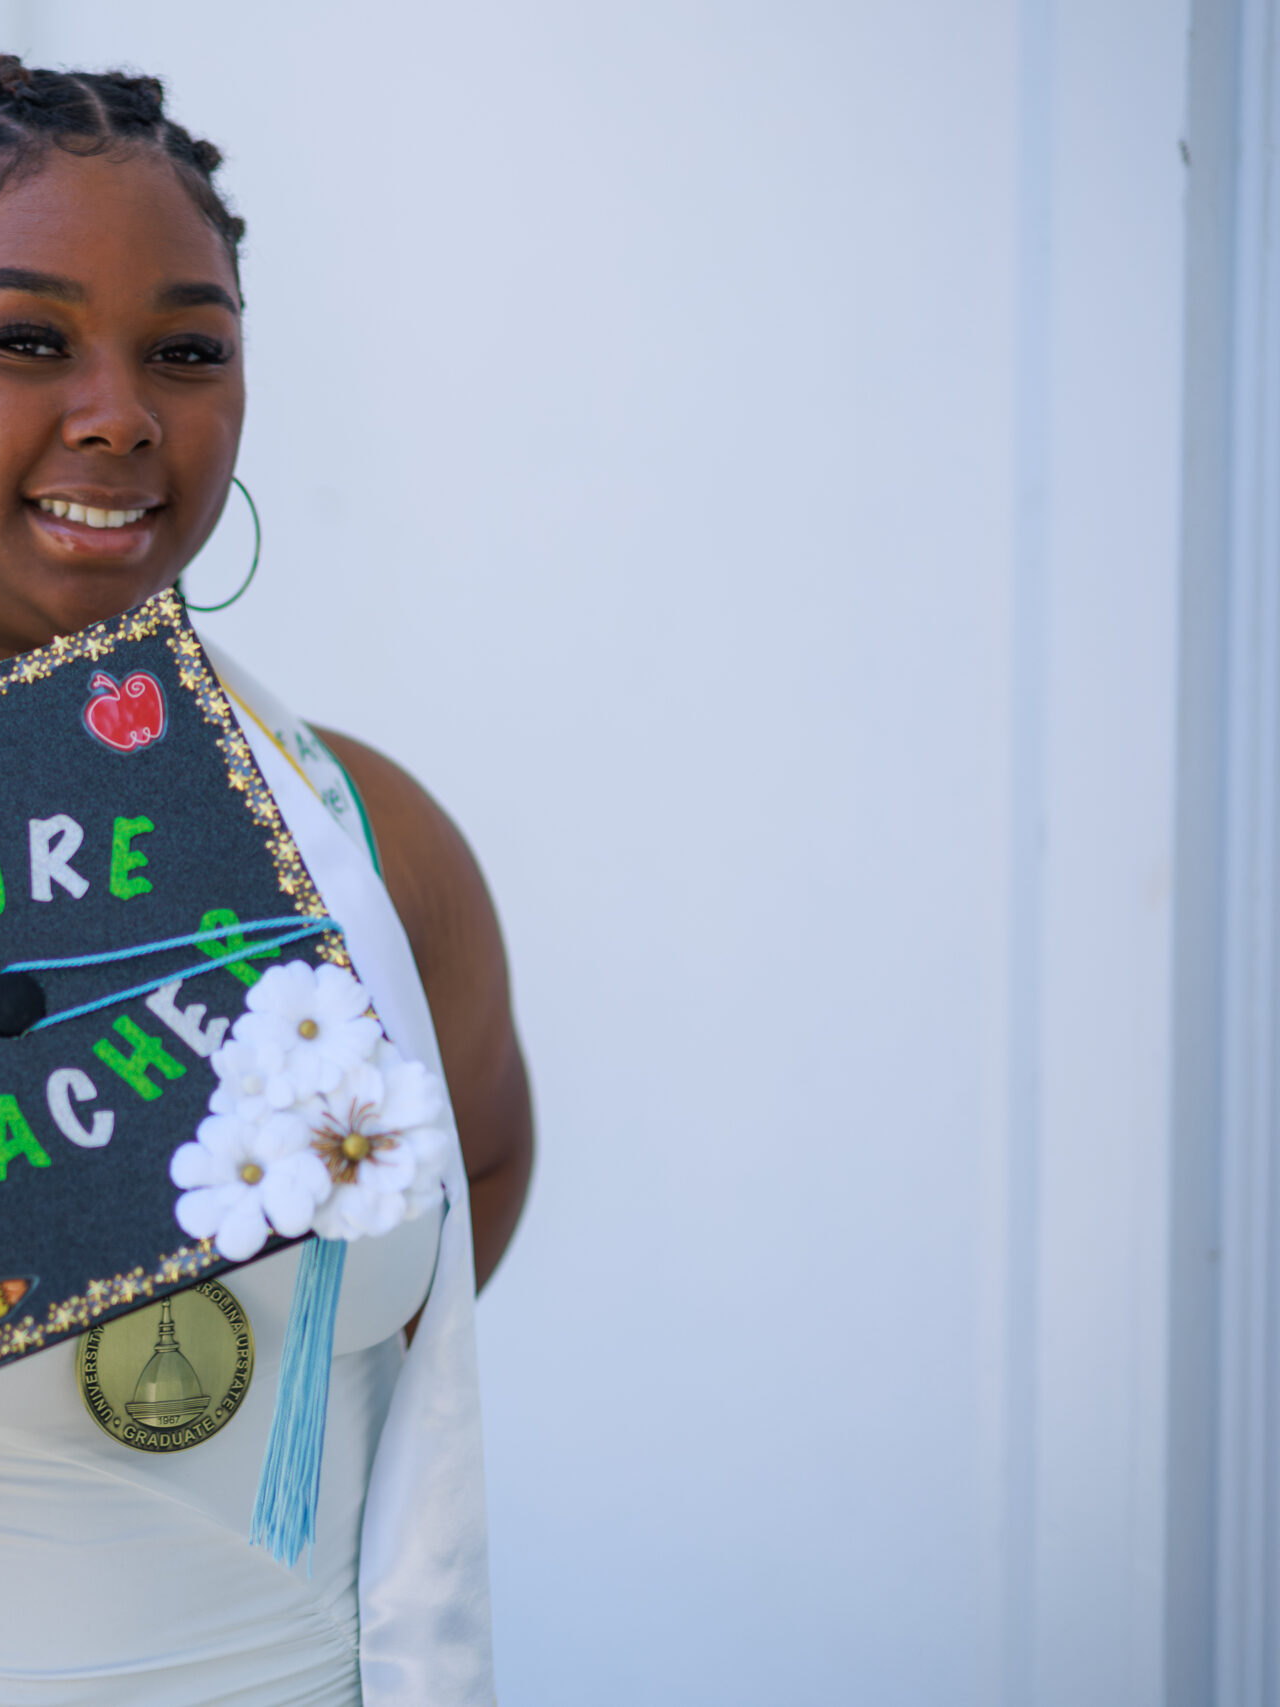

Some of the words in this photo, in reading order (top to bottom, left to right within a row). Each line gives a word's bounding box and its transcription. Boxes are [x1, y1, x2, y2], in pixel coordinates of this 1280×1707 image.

[85, 1324, 114, 1422] UNIVERSITY
[196, 1282, 244, 1335] ROLINA
[222, 1335, 249, 1410] UPSTATE
[122, 1417, 216, 1448] GRADUATE
